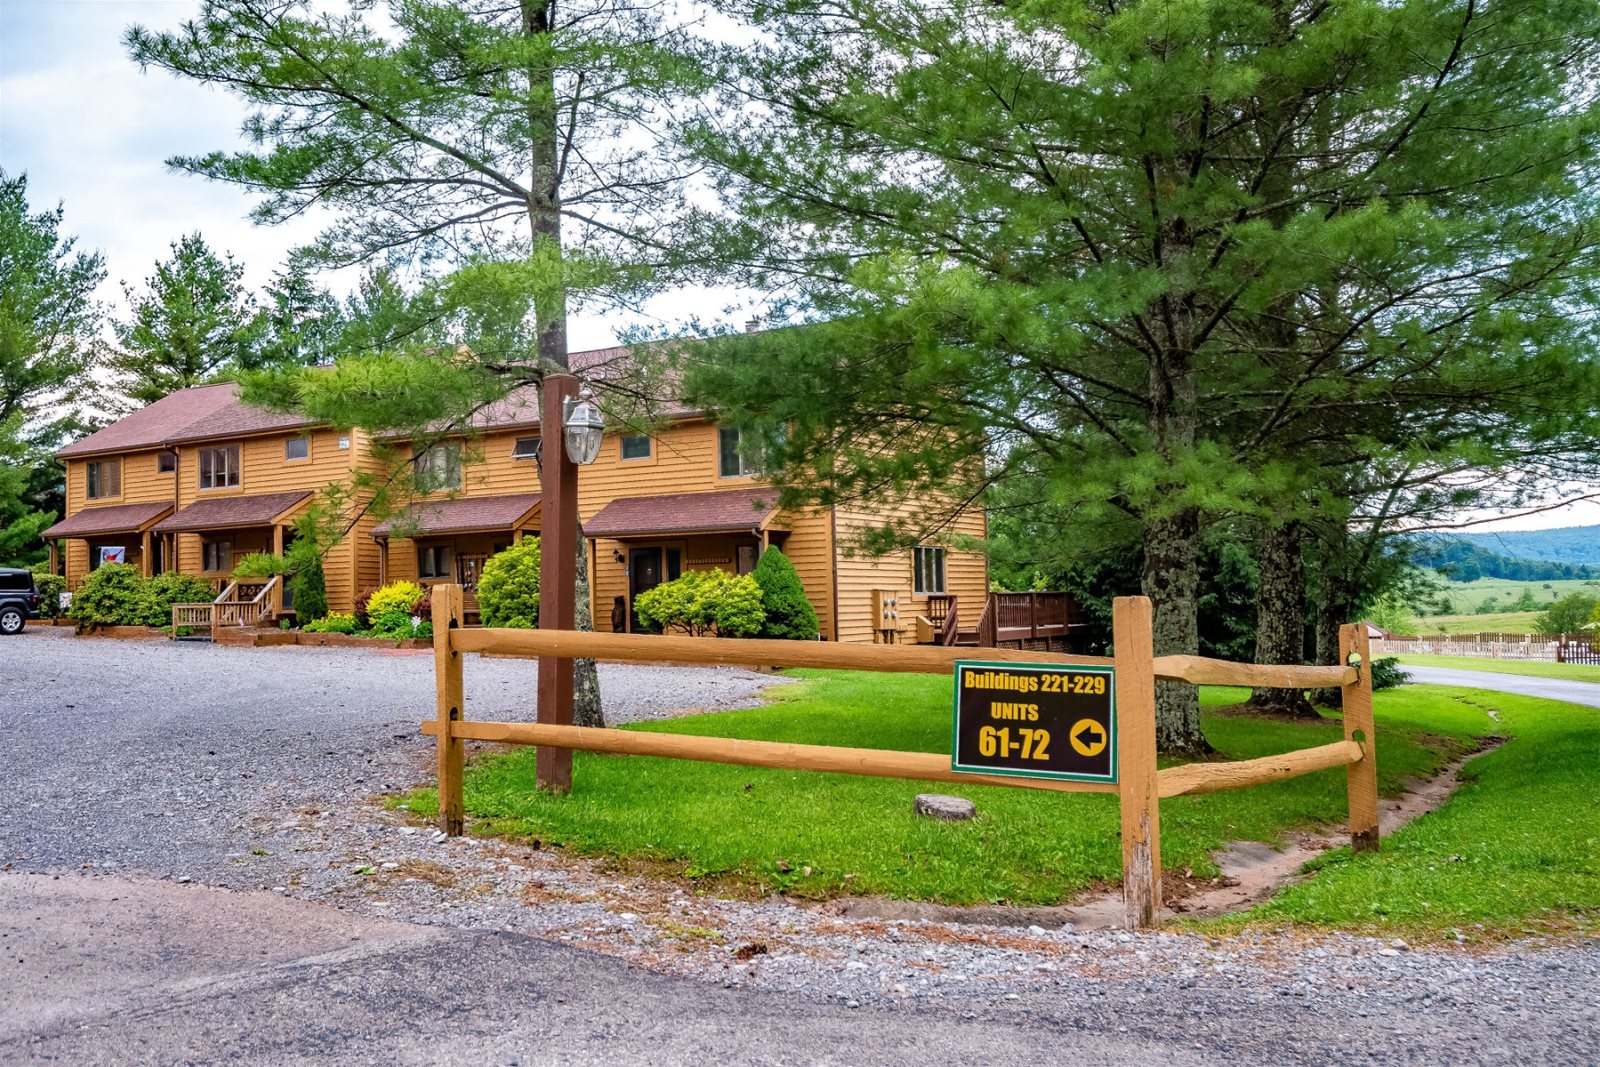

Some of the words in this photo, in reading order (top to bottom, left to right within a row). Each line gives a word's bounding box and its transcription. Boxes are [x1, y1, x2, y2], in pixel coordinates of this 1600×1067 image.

[964, 671, 1038, 693] Buildings
[1041, 674, 1106, 695] 221-229
[991, 702, 1039, 721] UNITS
[979, 725, 1051, 760] 61-72
